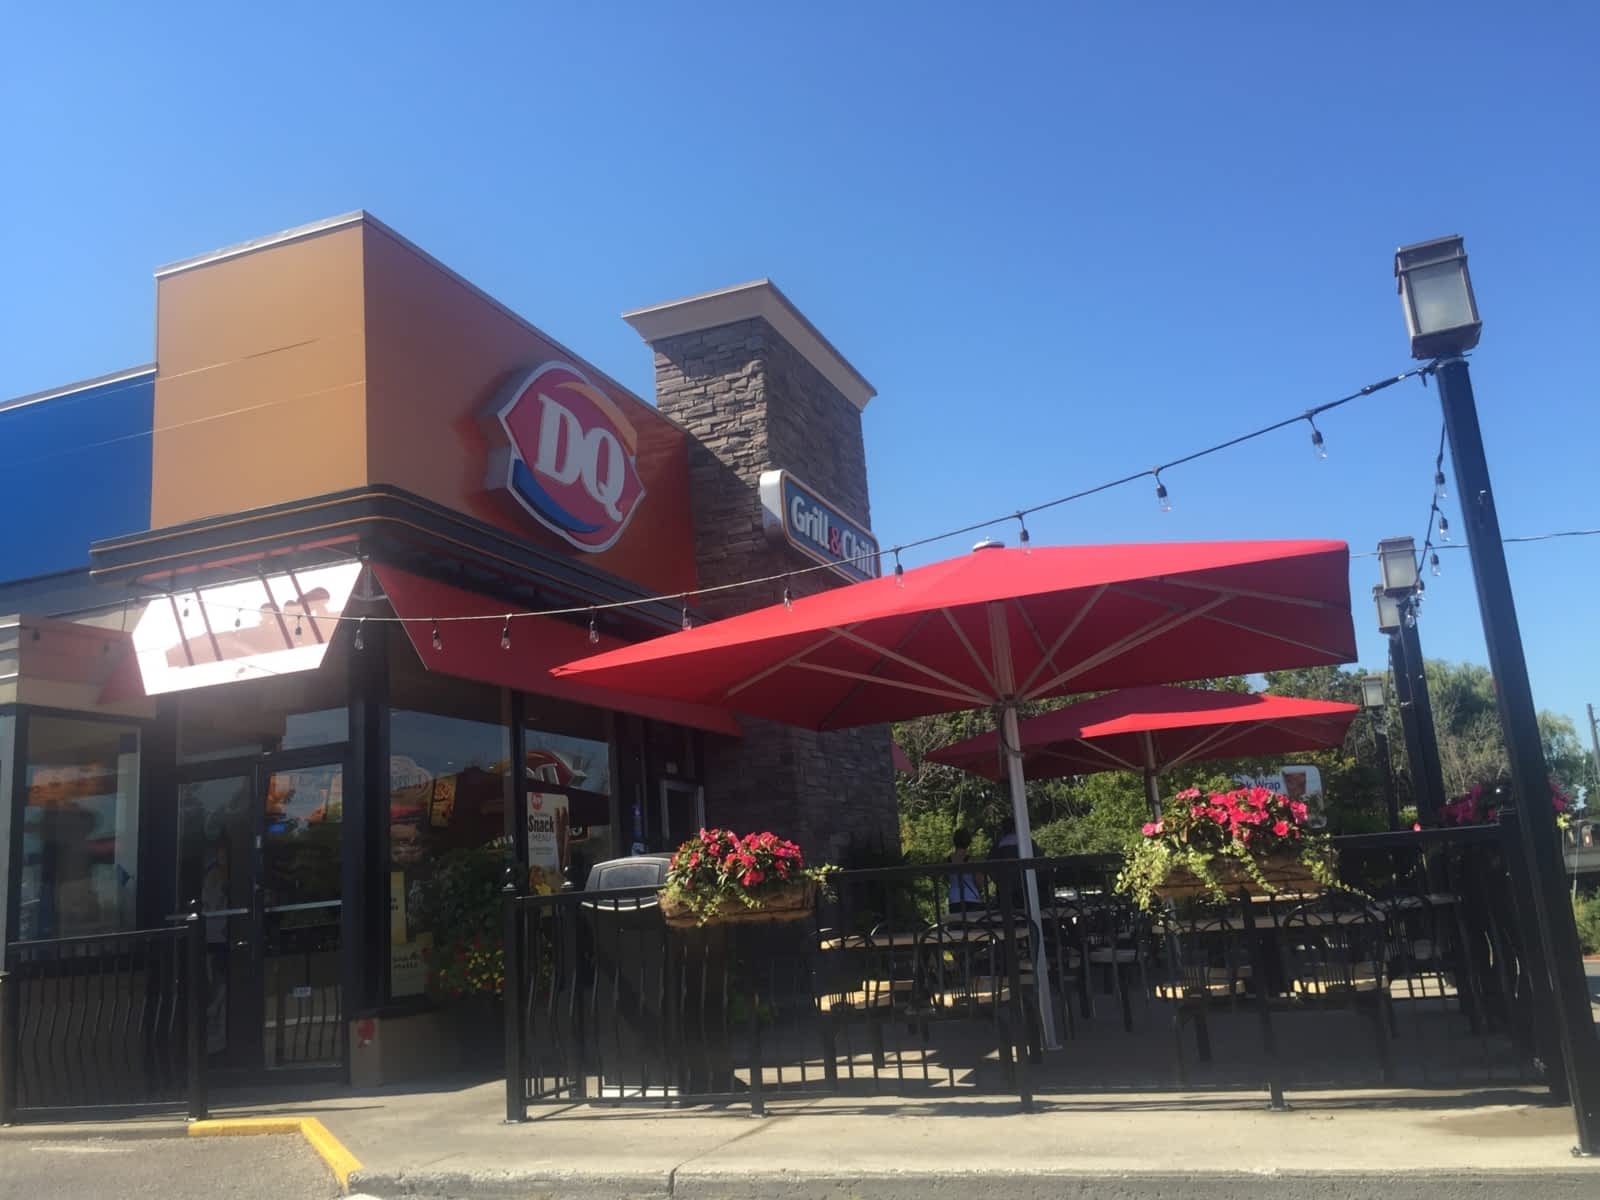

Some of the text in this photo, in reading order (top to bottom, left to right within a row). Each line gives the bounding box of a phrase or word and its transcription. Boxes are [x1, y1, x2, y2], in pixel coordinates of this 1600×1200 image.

[535, 393, 625, 523] DQ
[790, 495, 830, 549] Grill
[528, 815, 554, 832] Snack
